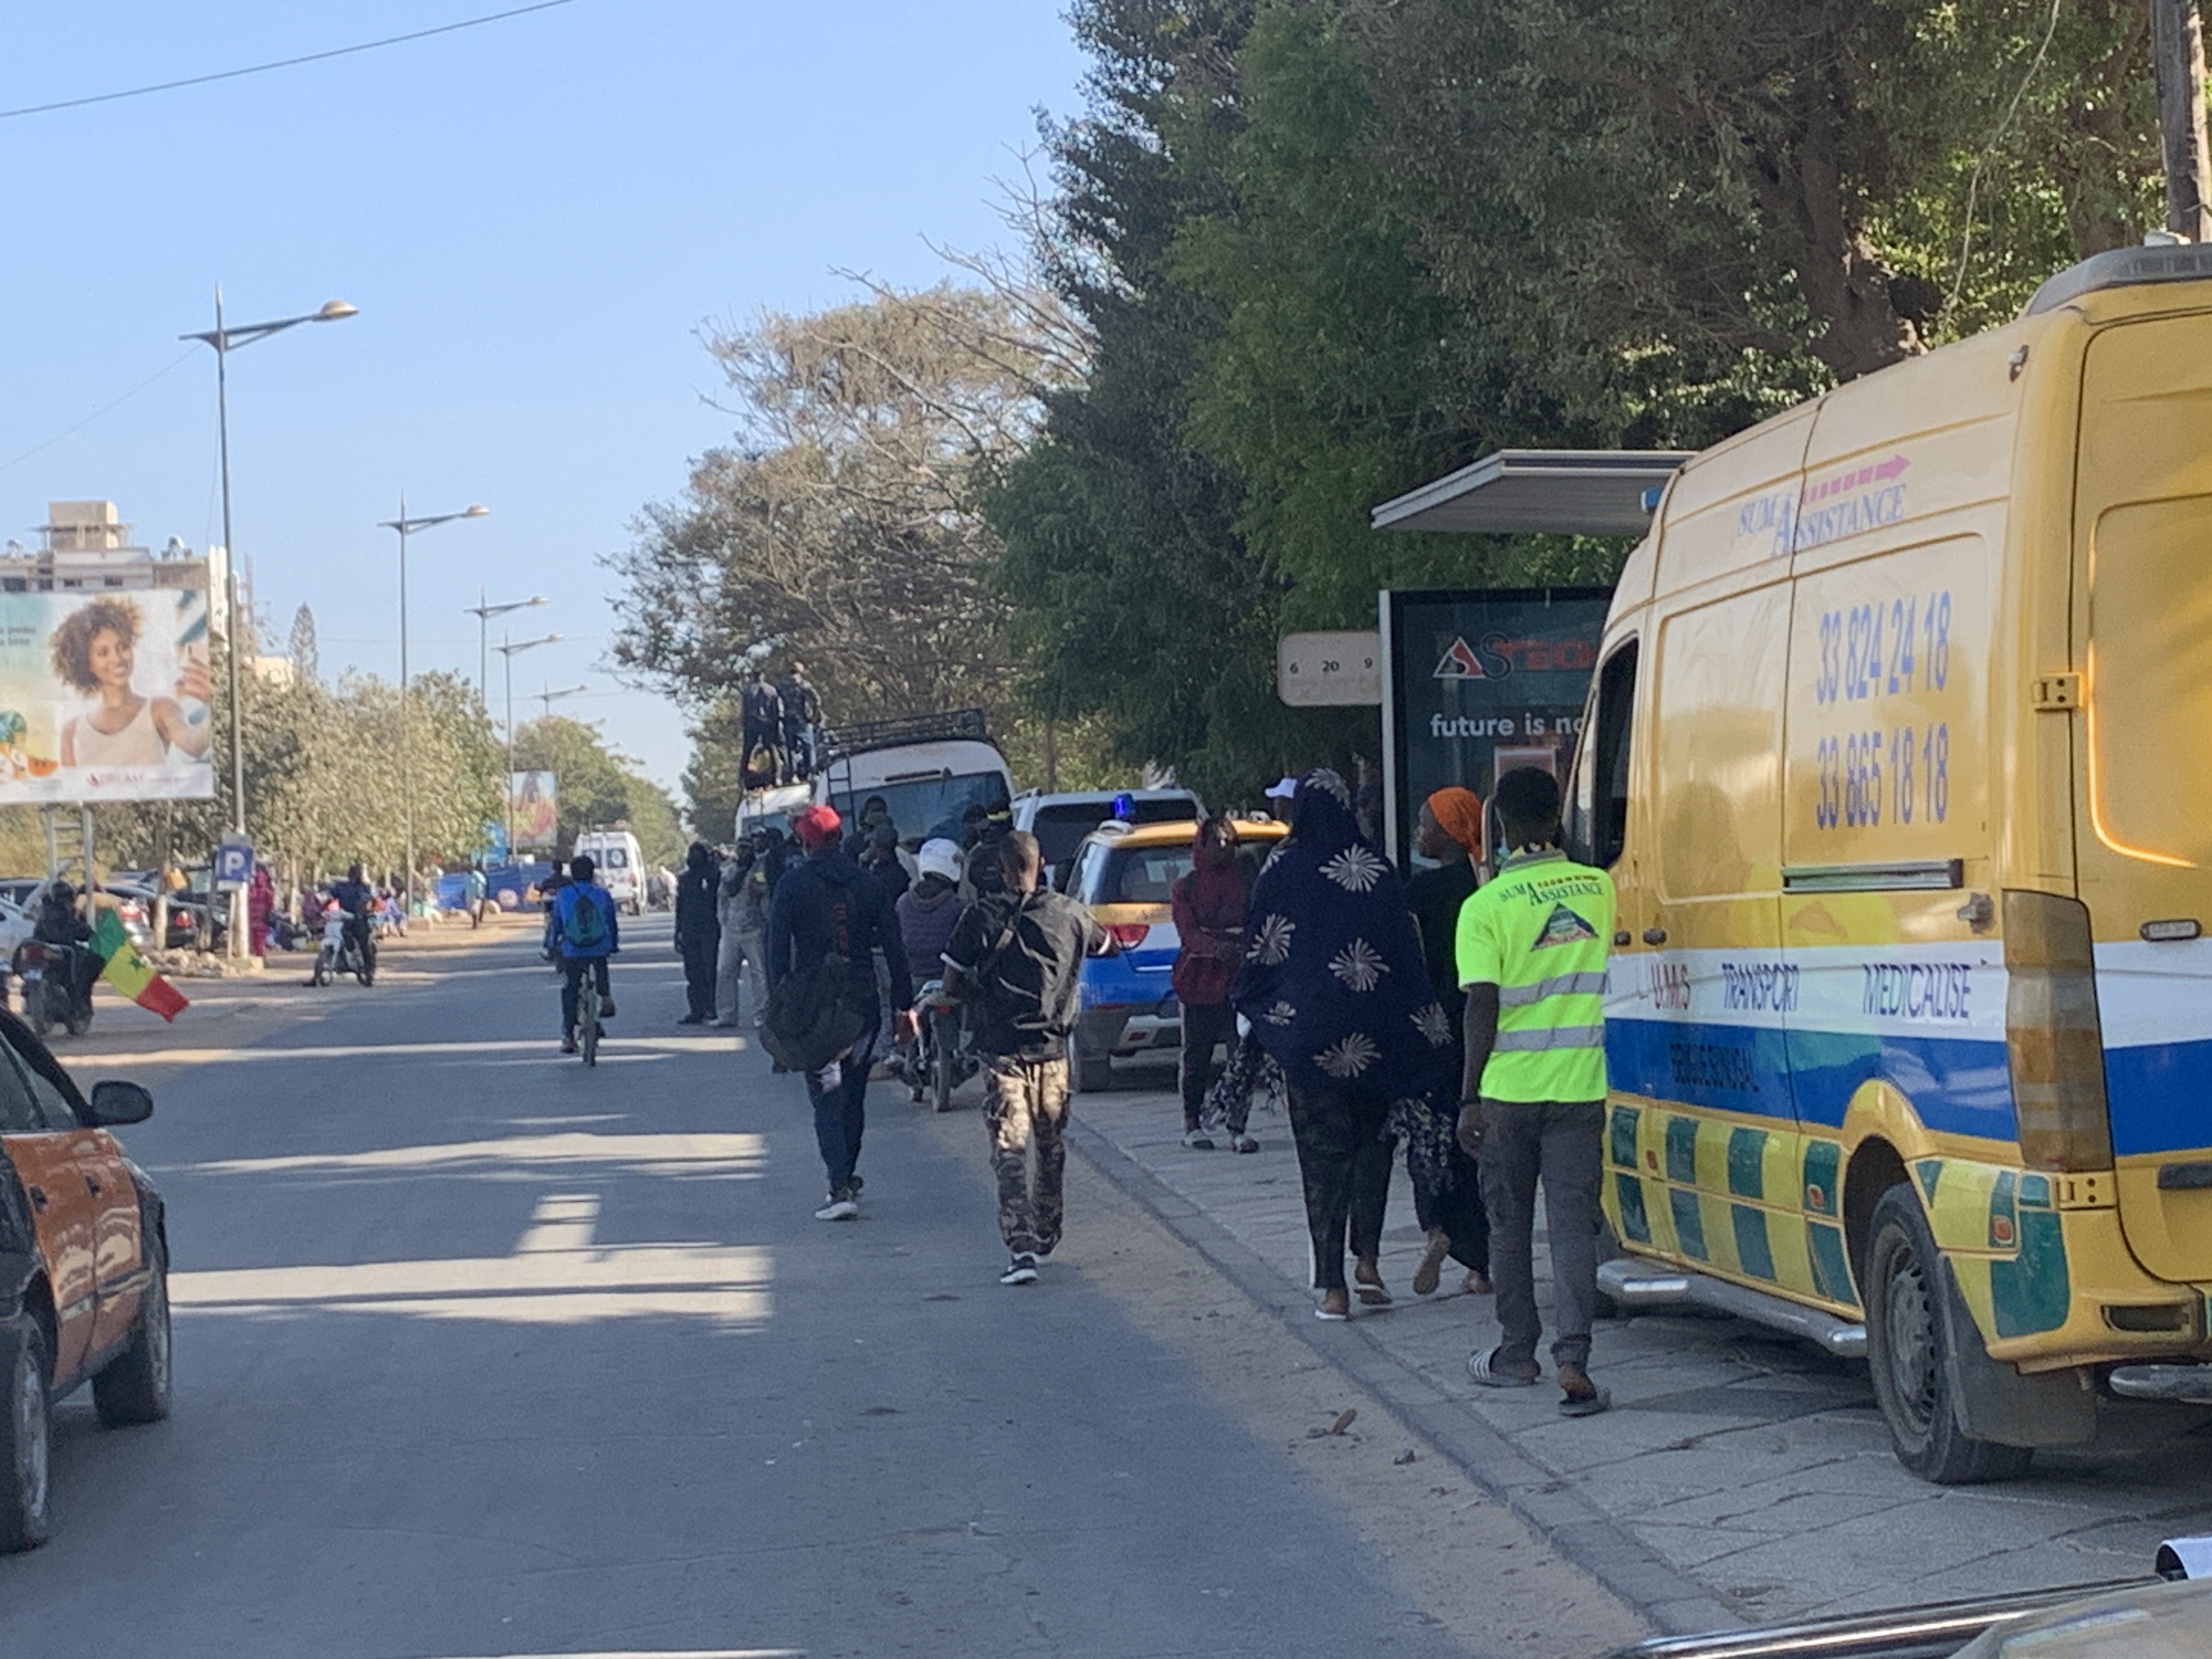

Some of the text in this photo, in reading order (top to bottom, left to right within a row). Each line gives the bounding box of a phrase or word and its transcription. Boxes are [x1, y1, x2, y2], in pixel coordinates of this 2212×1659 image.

[1290, 657, 1373, 674] 6 20 9
[1816, 590, 1951, 705] 33 824 24 18
[1430, 712, 1583, 737] future is no
[1816, 722, 1949, 830] 33 865 18 18
[224, 851, 245, 876] P
[1722, 962, 1800, 1012] TRANSPORT
[1862, 963, 1972, 1019] MEDICALISE
